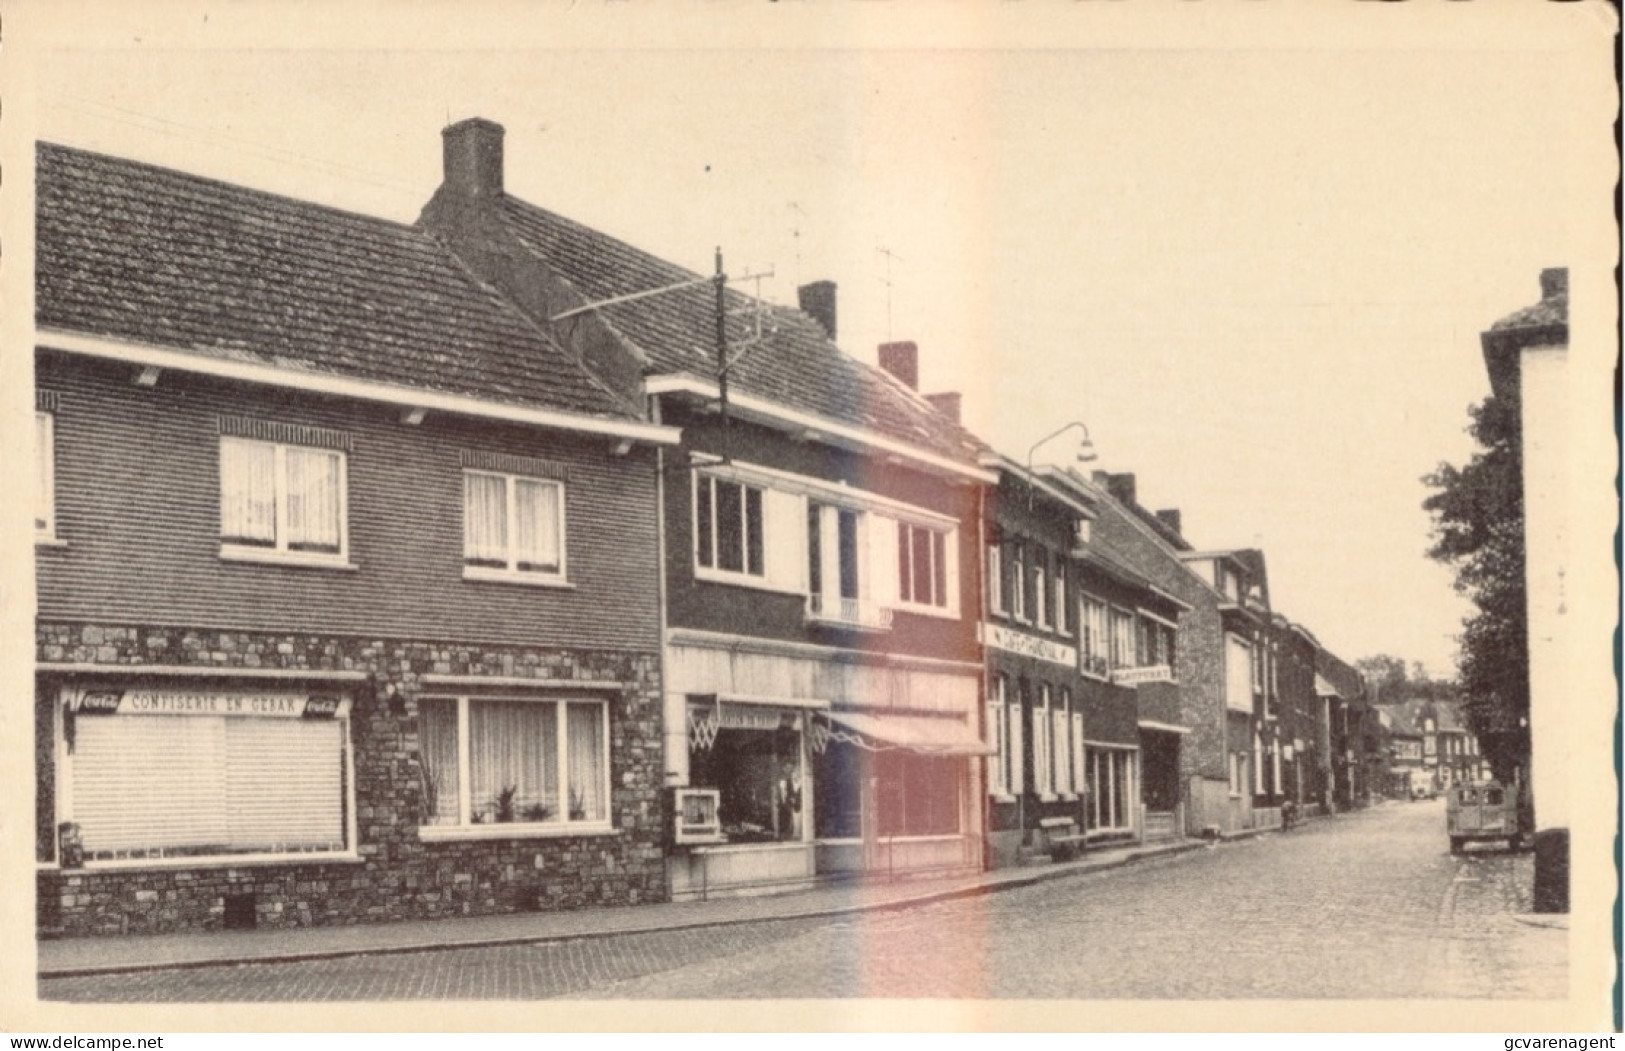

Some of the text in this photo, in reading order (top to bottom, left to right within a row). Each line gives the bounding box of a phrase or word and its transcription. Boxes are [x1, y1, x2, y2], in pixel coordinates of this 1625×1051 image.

[132, 693, 295, 712] CONFISERIE EN GEBAK
